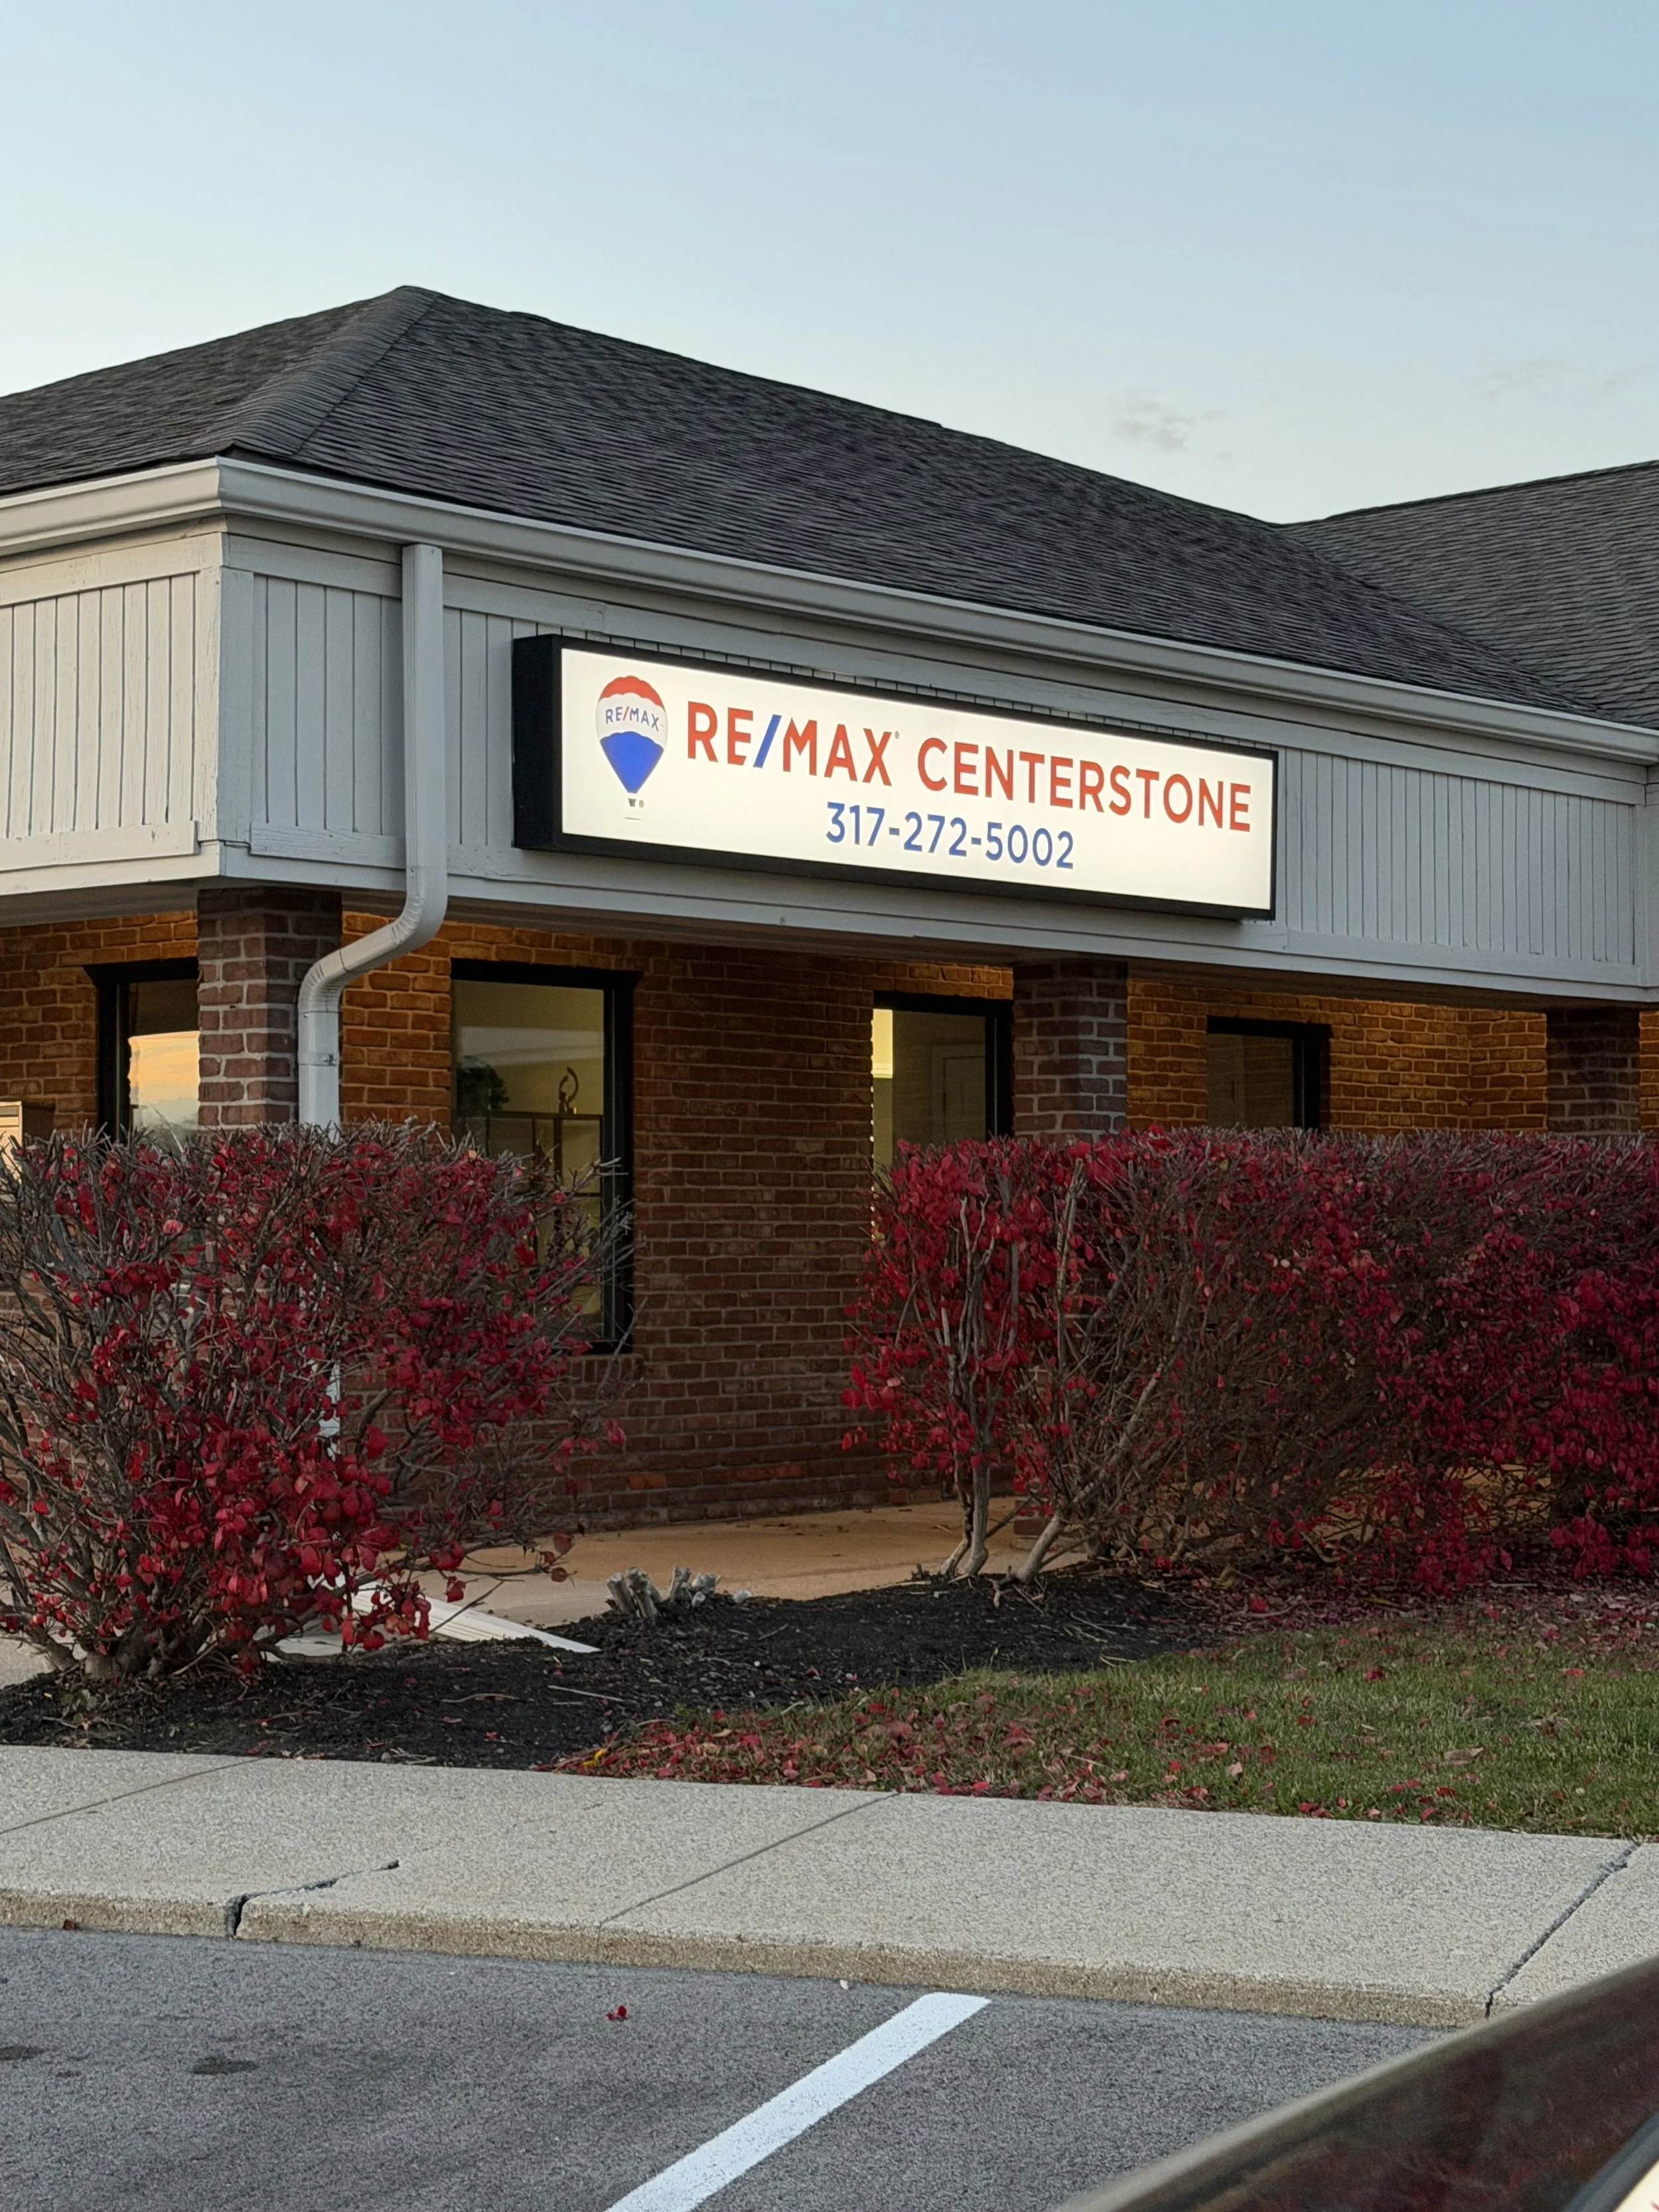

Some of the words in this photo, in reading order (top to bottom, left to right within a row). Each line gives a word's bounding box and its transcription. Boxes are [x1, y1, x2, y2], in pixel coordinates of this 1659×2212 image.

[605, 705, 660, 731] RE/MAX
[687, 701, 892, 786] RE/MAX
[918, 738, 1252, 832] CENTERSTONE
[826, 802, 1074, 869] 317-272-5002
